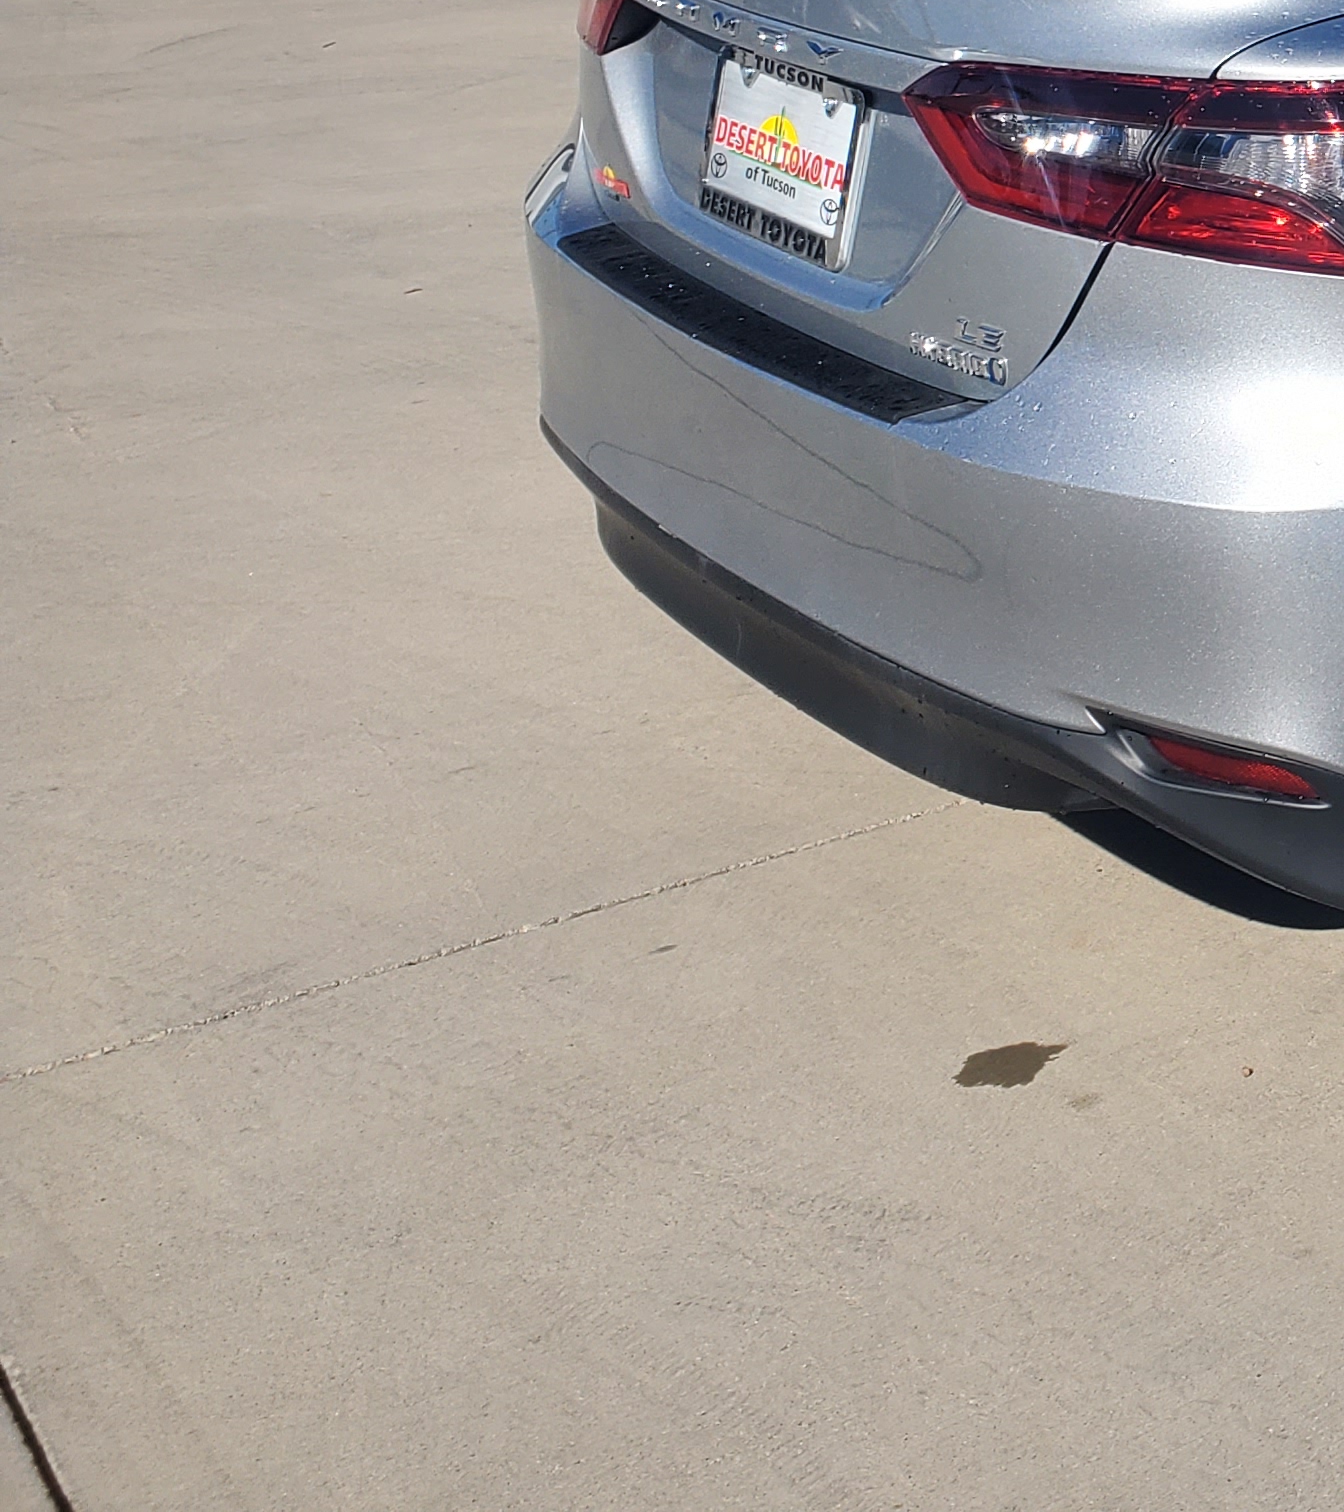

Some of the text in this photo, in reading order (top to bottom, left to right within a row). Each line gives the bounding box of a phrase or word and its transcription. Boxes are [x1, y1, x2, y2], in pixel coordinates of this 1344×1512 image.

[754, 53, 825, 91] TUCSON
[715, 115, 845, 190] DESERT TOYOTA
[745, 165, 797, 200] of Tucson
[700, 189, 827, 267] DESERT TOYOTA
[953, 316, 1006, 353] LE
